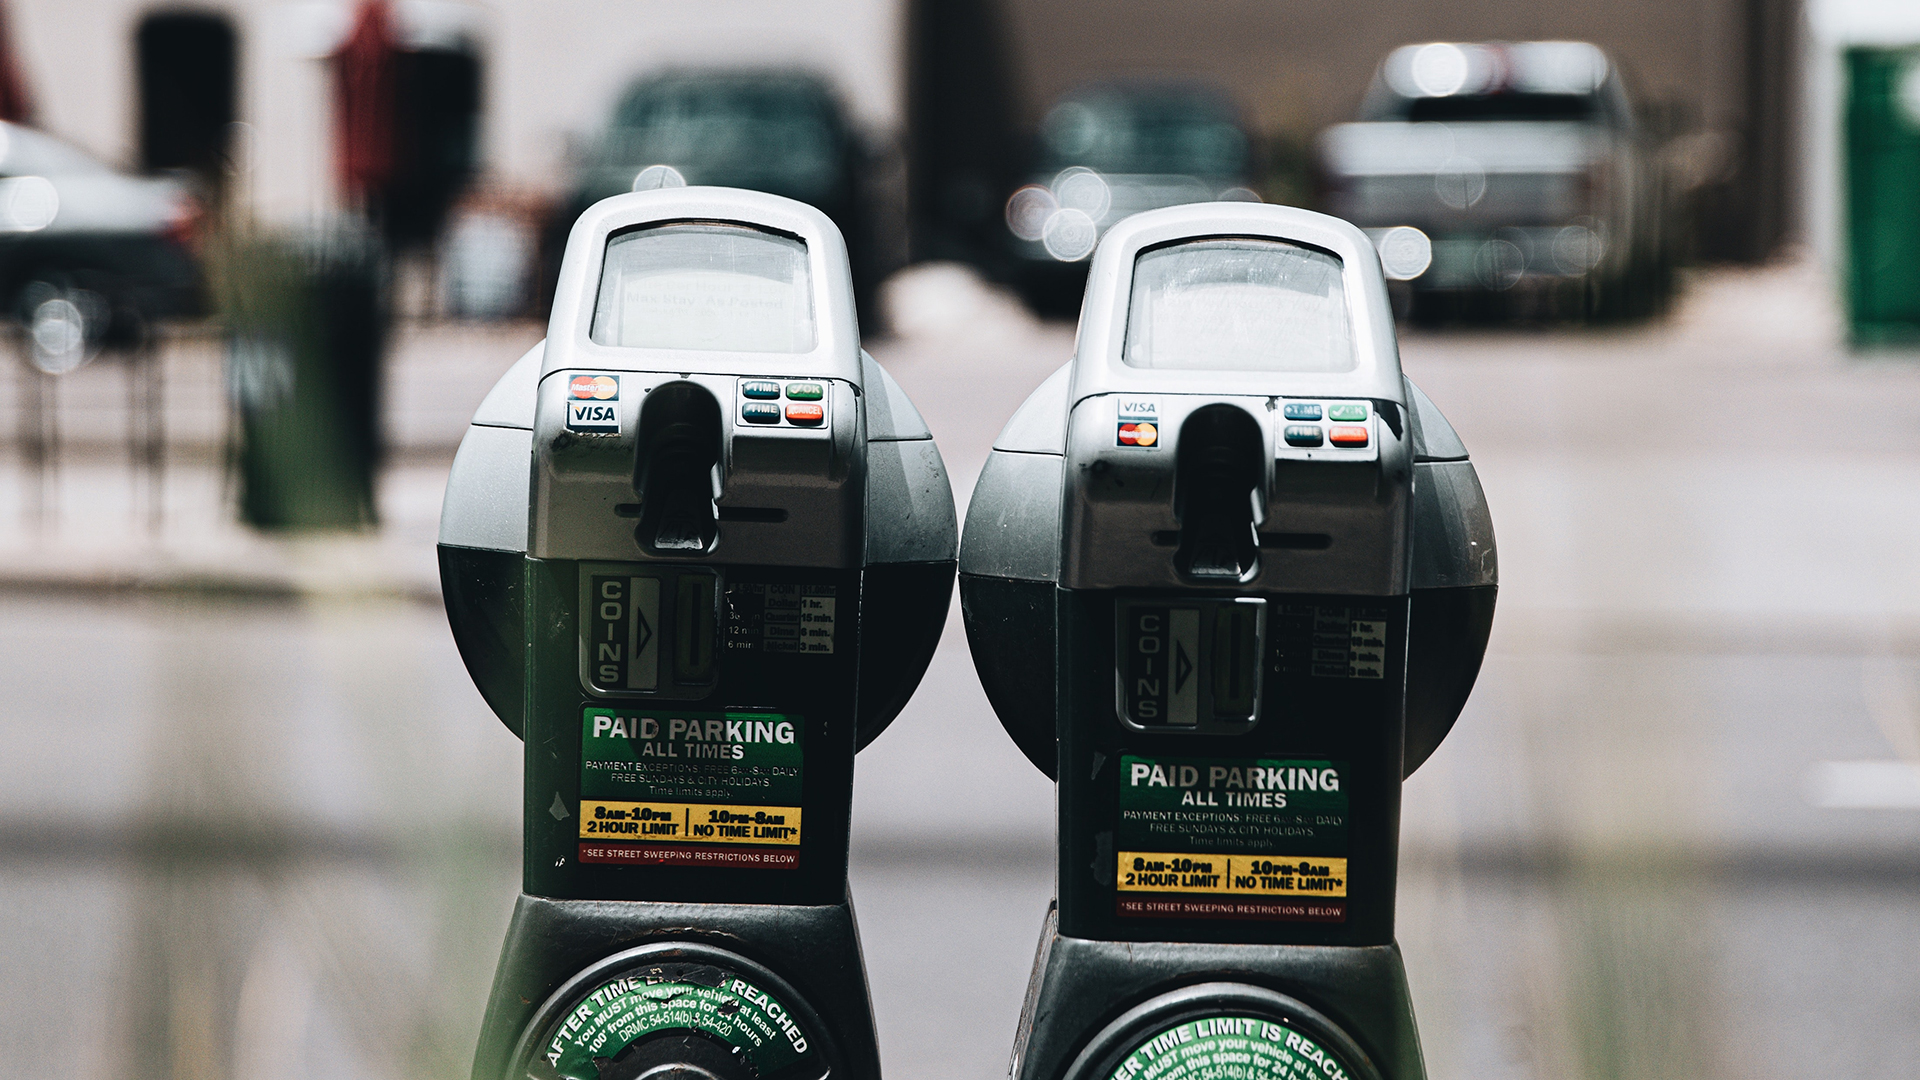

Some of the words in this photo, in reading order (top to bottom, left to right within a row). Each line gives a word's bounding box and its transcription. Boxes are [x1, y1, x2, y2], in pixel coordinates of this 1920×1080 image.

[627, 292, 657, 303] Max
[803, 385, 820, 393] OK
[574, 406, 615, 420] VISA
[1124, 402, 1155, 412] VISA
[770, 585, 795, 594] COIN
[768, 598, 798, 607] Dollar
[801, 600, 807, 608] 1
[810, 600, 823, 608] hr.
[766, 613, 798, 621] Quarter
[814, 614, 833, 622] min.
[599, 580, 623, 683] COINS
[729, 626, 739, 635] 12
[770, 627, 795, 635] Dime
[801, 628, 807, 636] 6
[809, 628, 830, 637] min.
[727, 640, 734, 649] 6
[767, 642, 797, 650] Nickel
[800, 643, 806, 651] 3
[809, 643, 829, 651] min.
[1137, 614, 1160, 718] COINS
[593, 715, 660, 739] PAID
[669, 719, 795, 745] PARKING
[642, 742, 678, 757] ALL
[685, 743, 745, 760] TIMES
[585, 761, 633, 772] PAYMENT
[705, 765, 729, 775] FREE
[772, 766, 799, 777] DAILY
[611, 773, 636, 783] FREE
[638, 773, 685, 785] SUNDAYS
[688, 776, 695, 785] &
[698, 776, 719, 786] CITY
[1131, 763, 1199, 788] PAID
[1209, 765, 1340, 792] PARKING
[650, 786, 673, 796] Time
[676, 787, 702, 796] limits
[1181, 791, 1219, 807] ALL
[1225, 792, 1287, 808] TIMES
[594, 806, 671, 822] 8AM-10PM
[709, 810, 784, 825] 10PM-8AM
[1123, 810, 1172, 821] PAYMENT
[1245, 814, 1272, 824] FREE
[1316, 815, 1344, 826] DAILY
[587, 822, 597, 833] 2
[598, 821, 638, 834] HOUR
[641, 823, 679, 835] LIMIT
[694, 825, 714, 836] NO
[718, 825, 750, 838] TIME
[1150, 824, 1176, 833] FREE
[1178, 824, 1226, 835] SUNDAYS
[1228, 825, 1236, 835] &
[1239, 825, 1260, 835] CITY
[1190, 836, 1214, 847] Time
[1216, 837, 1244, 847] limits
[607, 849, 640, 858] STREET
[643, 850, 692, 860] SWEEPING
[695, 851, 761, 862] RESTRICTIONS
[763, 854, 795, 863] BELOW
[1133, 858, 1212, 873] 8AM-10PM
[1251, 861, 1329, 876] 10PM-8AM
[1126, 873, 1135, 886] 2
[1138, 873, 1178, 887] HOUR
[1182, 874, 1220, 888] LIMIT
[1235, 876, 1256, 889] NO
[1260, 876, 1294, 890] TIME
[1146, 903, 1181, 912] STREET
[1184, 903, 1234, 914] SWEEPING
[1237, 905, 1305, 916] RESTRICTIONS
[1308, 907, 1342, 917] BELOW
[547, 1004, 594, 1068] AFTER
[590, 977, 641, 1007] TIME
[730, 978, 808, 1054] REACHED
[574, 1024, 596, 1048] You
[594, 998, 627, 1028] MUST
[630, 988, 663, 1005] move
[666, 987, 694, 998] your
[739, 1005, 752, 1018] at
[752, 1012, 777, 1040] least
[607, 1011, 634, 1034] from
[635, 1001, 658, 1016] this
[661, 999, 697, 1010] space
[700, 999, 717, 1013] for
[733, 1015, 763, 1047] hours
[619, 1018, 649, 1042] DRMC
[649, 1010, 692, 1027] 54-514(b)
[702, 1014, 732, 1037] 54-420
[1139, 1025, 1192, 1061] TIME
[1196, 1018, 1255, 1038] LIMIT
[1260, 1022, 1282, 1042] IS
[1143, 1050, 1178, 1080] MUST
[1180, 1040, 1216, 1059] move
[1218, 1039, 1248, 1052] your
[1250, 1040, 1293, 1065] vehicle
[1294, 1060, 1307, 1074] at
[1186, 1054, 1210, 1071] this
[1212, 1052, 1251, 1066] space
[1253, 1053, 1272, 1069] for
[1272, 1061, 1288, 1076] 24
[1247, 1066, 1254, 1080] &
